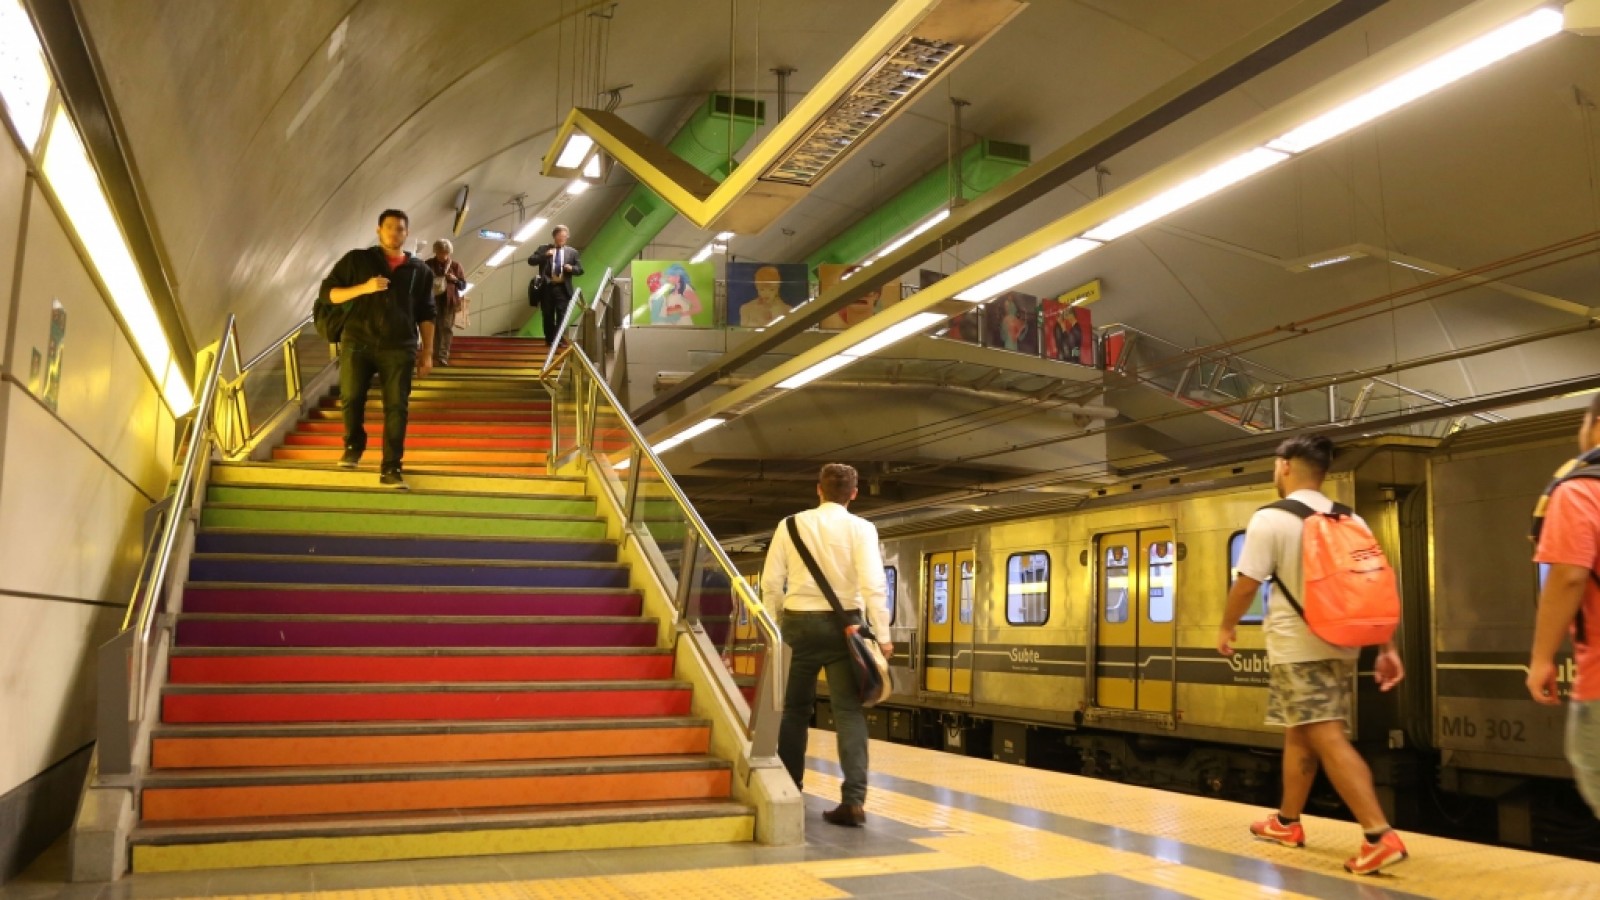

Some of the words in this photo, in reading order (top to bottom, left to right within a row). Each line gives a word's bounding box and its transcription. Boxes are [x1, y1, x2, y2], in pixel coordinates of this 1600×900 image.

[1010, 647, 1040, 663] Subte
[1232, 652, 1270, 673] Subt
[1442, 715, 1477, 738] Mb
[1484, 718, 1526, 742] 302
